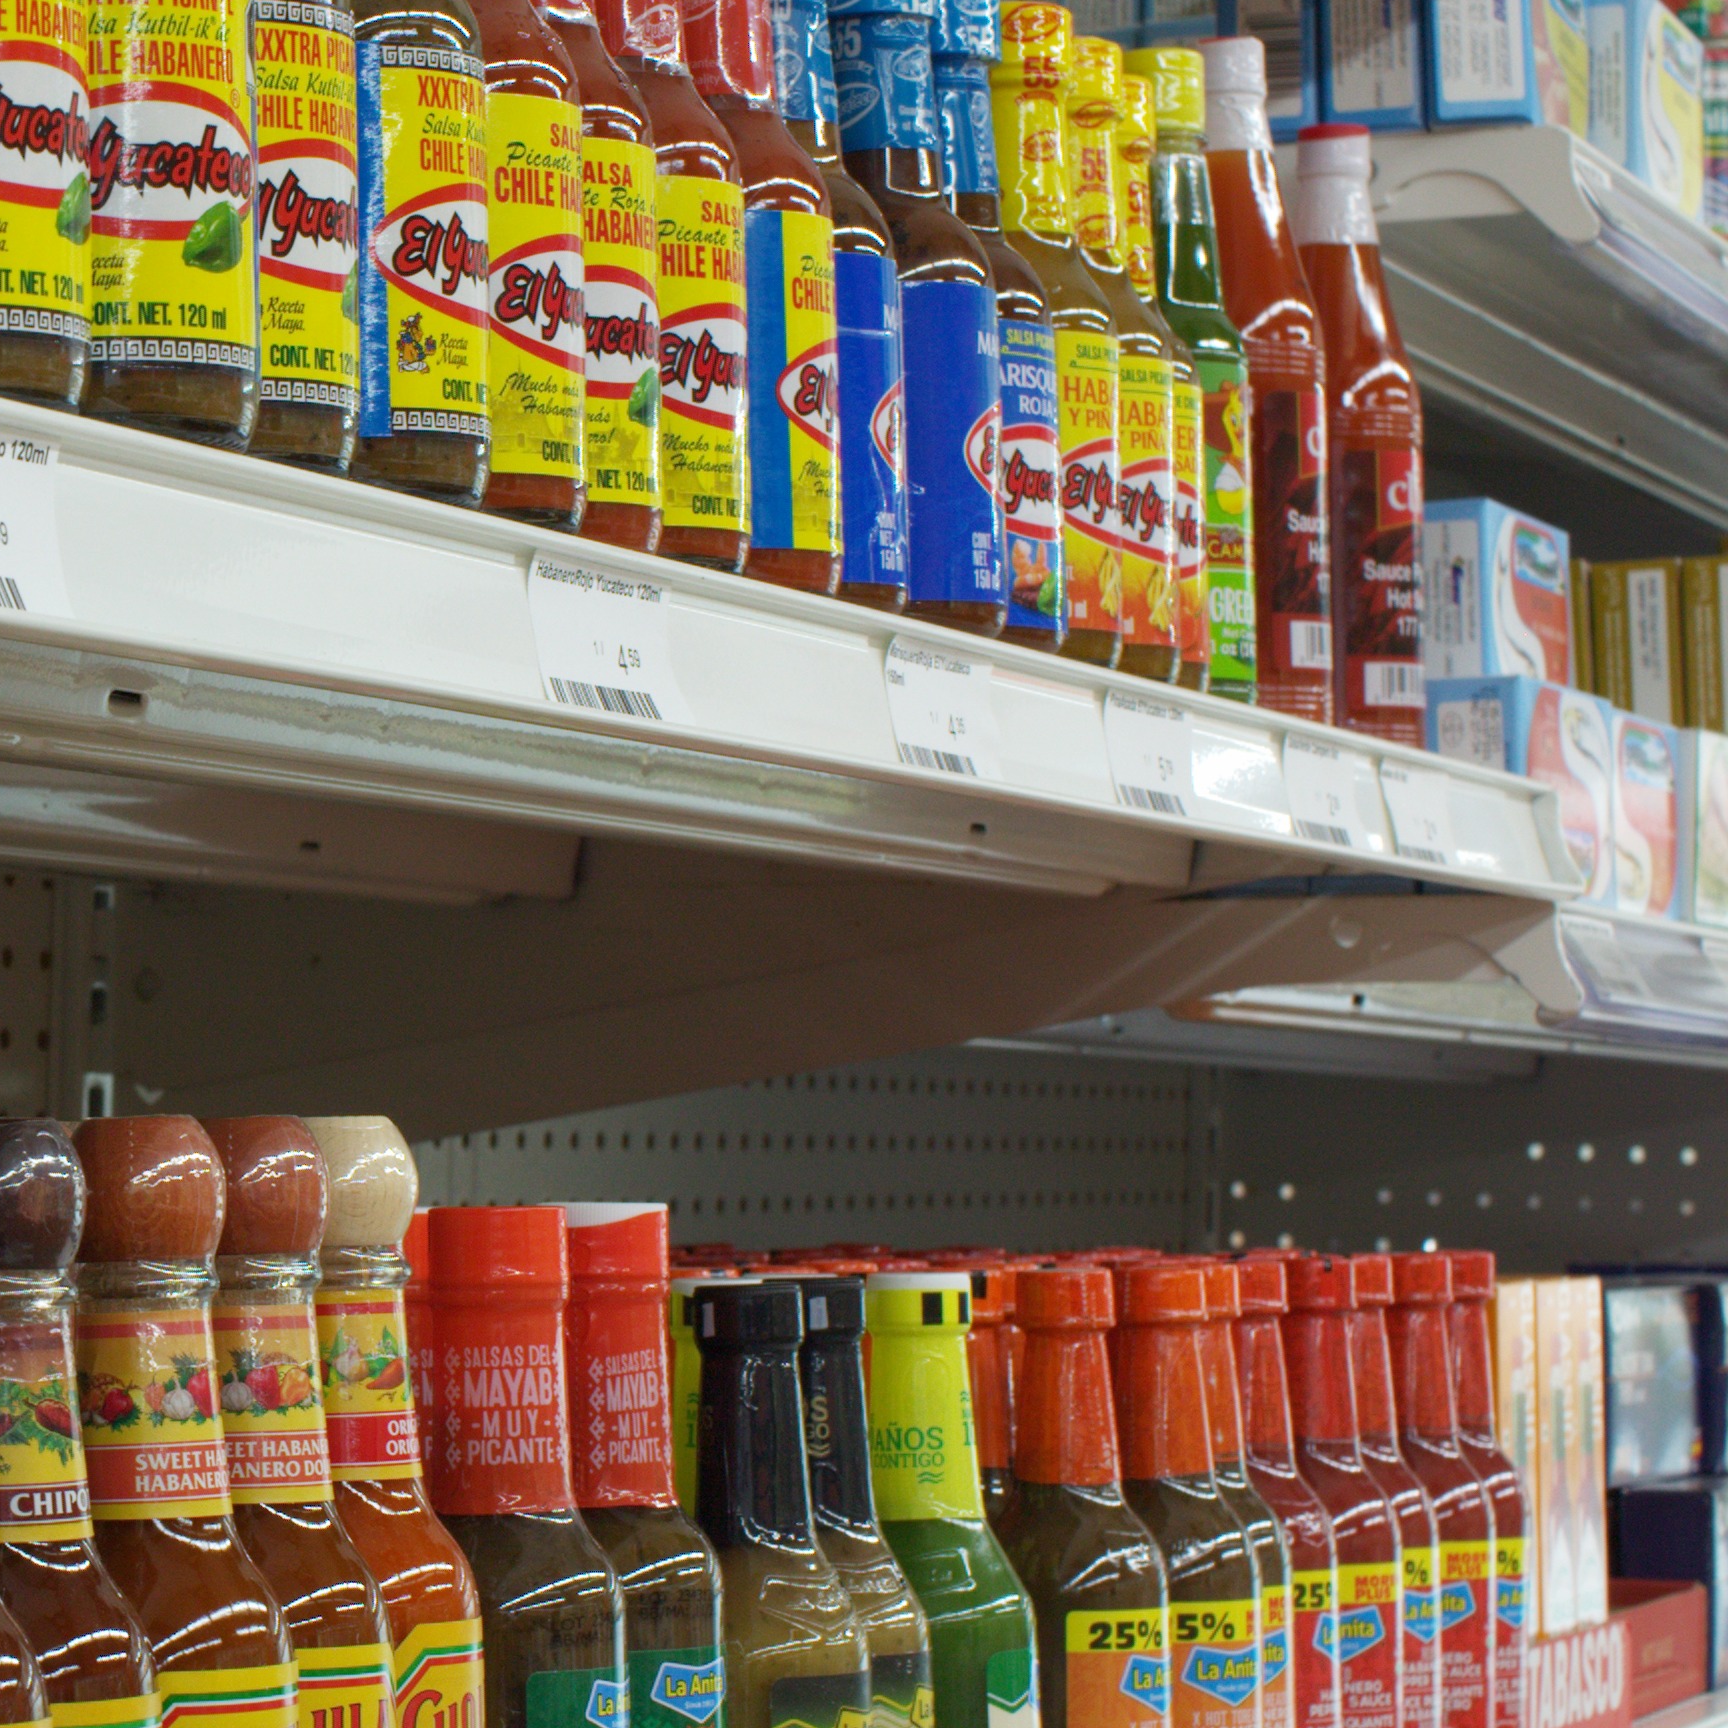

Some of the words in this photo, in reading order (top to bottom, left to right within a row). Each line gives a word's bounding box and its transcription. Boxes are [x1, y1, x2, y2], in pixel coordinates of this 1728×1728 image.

[133, 42, 234, 85] HABANERO
[422, 113, 461, 136] Salsa
[419, 139, 464, 173] CHILE
[495, 167, 555, 205] CHILE
[20, 271, 48, 295] NET.
[138, 301, 173, 327] NET.
[179, 303, 208, 328] 120
[212, 304, 226, 329] ml
[1006, 328, 1033, 345] SALSA
[270, 344, 312, 367] CONT.
[11, 441, 50, 465] 120ml
[536, 560, 593, 592] HabaneroRojo
[595, 574, 633, 597] Yucateco
[635, 584, 662, 603] 120ml
[464, 1347, 524, 1367] SALSAS
[528, 1345, 550, 1365] DEL
[464, 1370, 552, 1408] MAYAB
[607, 1371, 659, 1411] MAYAB
[136, 1450, 201, 1471] SWEET
[466, 1437, 554, 1465] PICANTE
[608, 1438, 661, 1465] PICANTE
[1197, 1660, 1221, 1679] La
[666, 1675, 687, 1697] La
